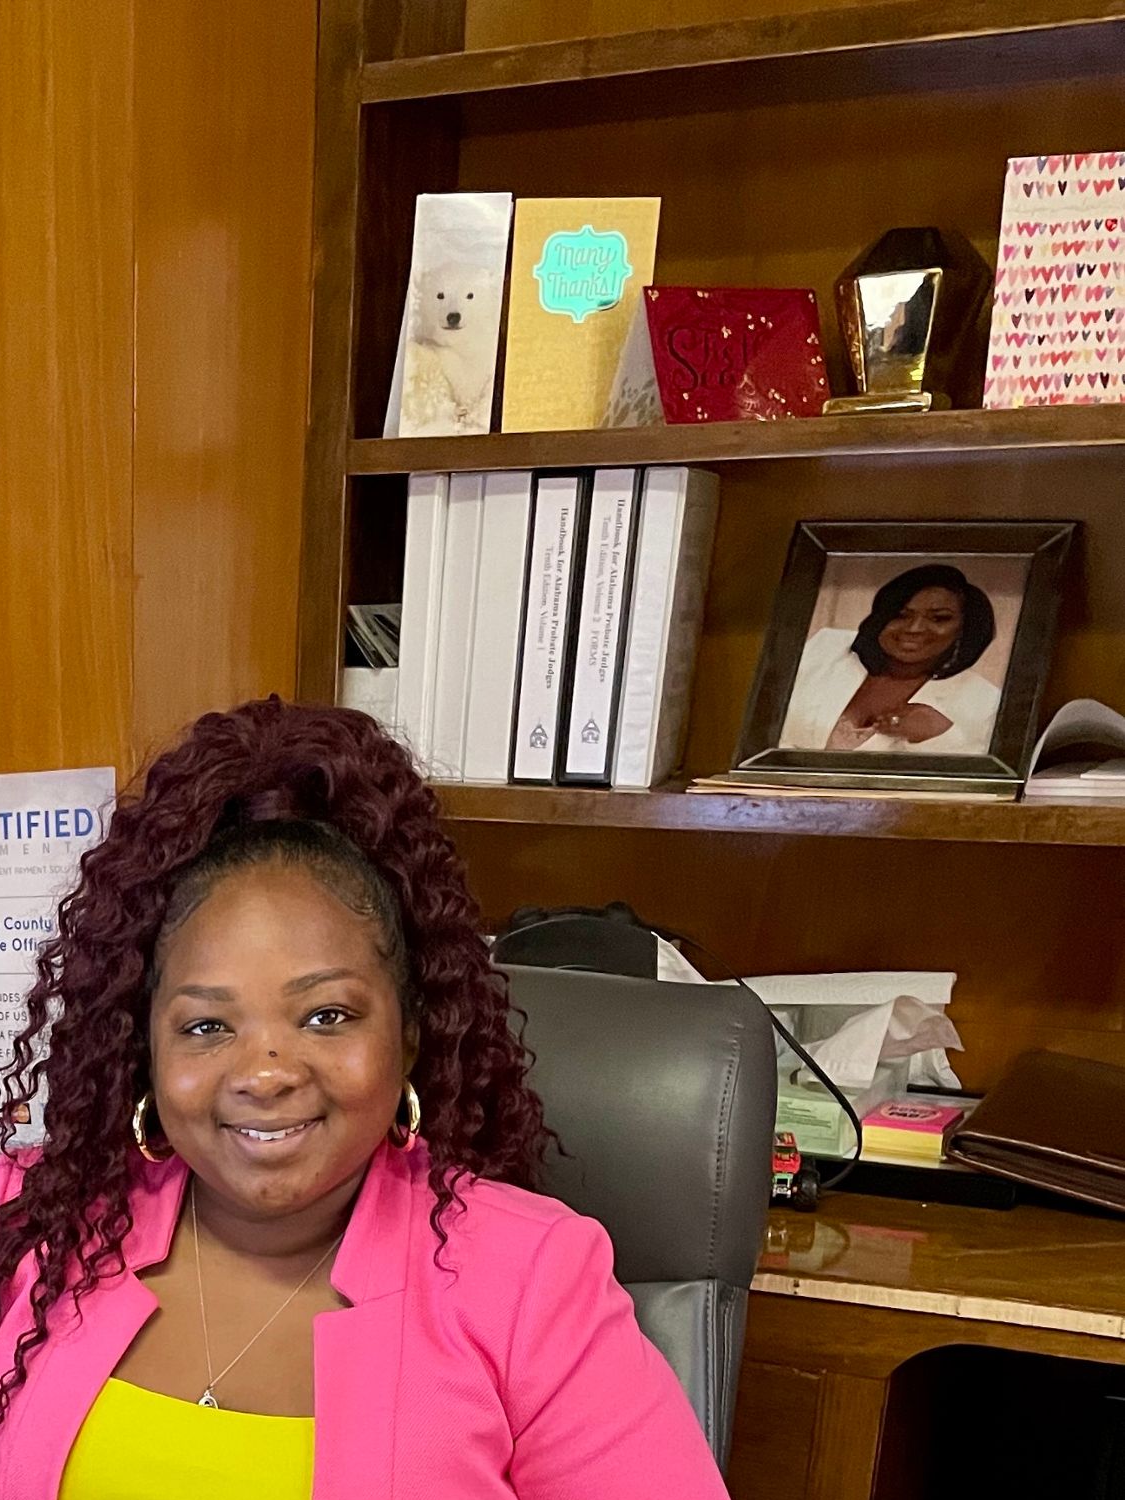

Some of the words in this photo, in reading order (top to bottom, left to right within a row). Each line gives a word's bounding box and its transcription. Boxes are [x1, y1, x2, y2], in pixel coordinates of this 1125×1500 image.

[555, 243, 617, 274] Many
[547, 271, 616, 301] Thanks!
[3, 916, 53, 933] County
[12, 937, 39, 951] Offi
[13, 1012, 27, 1022] US
